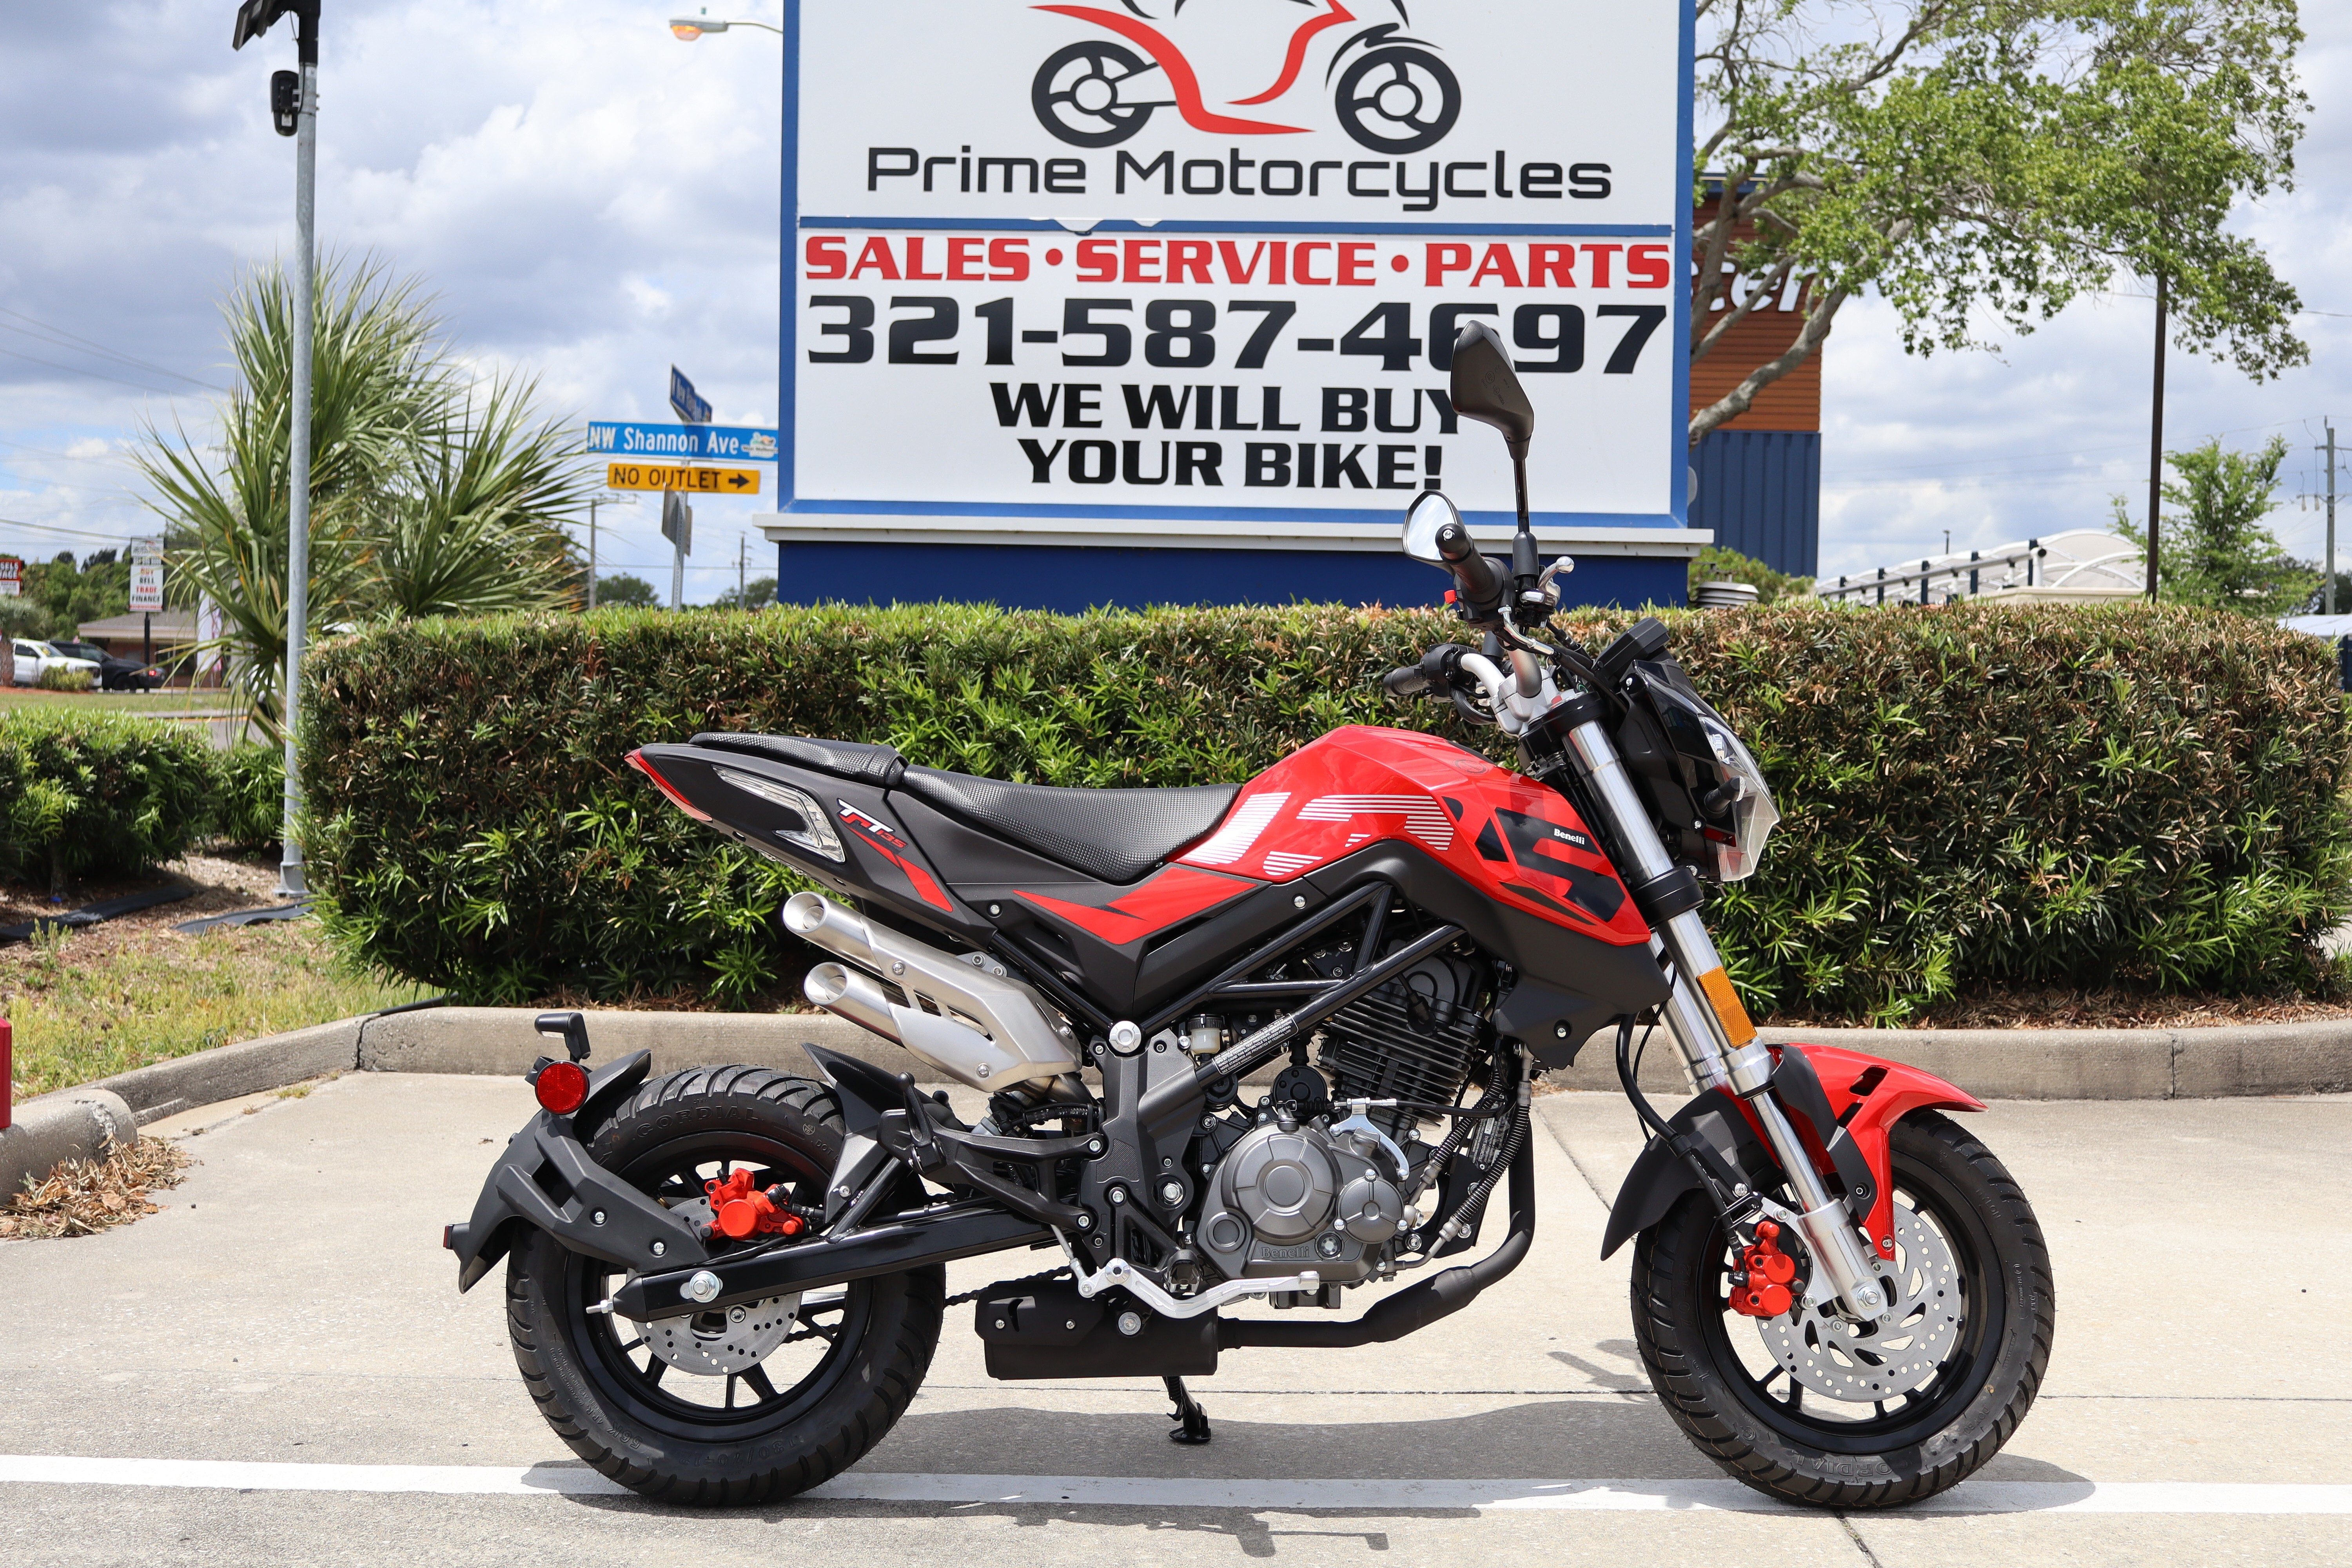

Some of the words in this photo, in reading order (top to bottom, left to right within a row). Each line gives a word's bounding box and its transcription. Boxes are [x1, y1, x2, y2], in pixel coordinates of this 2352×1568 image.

[868, 145, 1085, 193] Prime
[1116, 148, 1611, 211] Motorcycles
[807, 237, 1029, 281] SALES
[1077, 240, 1375, 285] SERVICE
[1426, 243, 1669, 288] PARTS
[990, 383, 1102, 428] WE
[1122, 385, 1300, 431] WILL
[1321, 388, 1459, 434] BUY
[590, 426, 617, 449] NW
[624, 427, 699, 452] Shannon
[707, 431, 739, 454] Ave
[614, 468, 639, 485] NO
[649, 469, 721, 488] OUTLET
[1018, 439, 1223, 485] YOUR
[1245, 443, 1441, 490] BIKE!
[1554, 828, 1585, 845] Benelli
[1227, 1054, 1238, 1062] CAUSE
[1243, 1039, 1263, 1053] MOTORCYCLE
[1267, 1031, 1279, 1040] EXCEED
[1278, 1024, 1292, 1034] FEDERAL
[1229, 1054, 1246, 1066] STANDARDS
[1251, 1041, 1269, 1054] PROHIBITED
[1271, 1032, 1285, 1042] FEDERAL
[1240, 1054, 1252, 1063] MANUAL
[633, 1103, 762, 1142] CORDIAL
[813, 1138, 835, 1156] DOT
[1477, 1143, 1486, 1162] MOTORCYCLE
[1261, 1246, 1310, 1258] Benelli
[1971, 1405, 1991, 1426] DOT
[604, 1418, 644, 1452] 56K
[1784, 1445, 1914, 1480] CORDIAL
